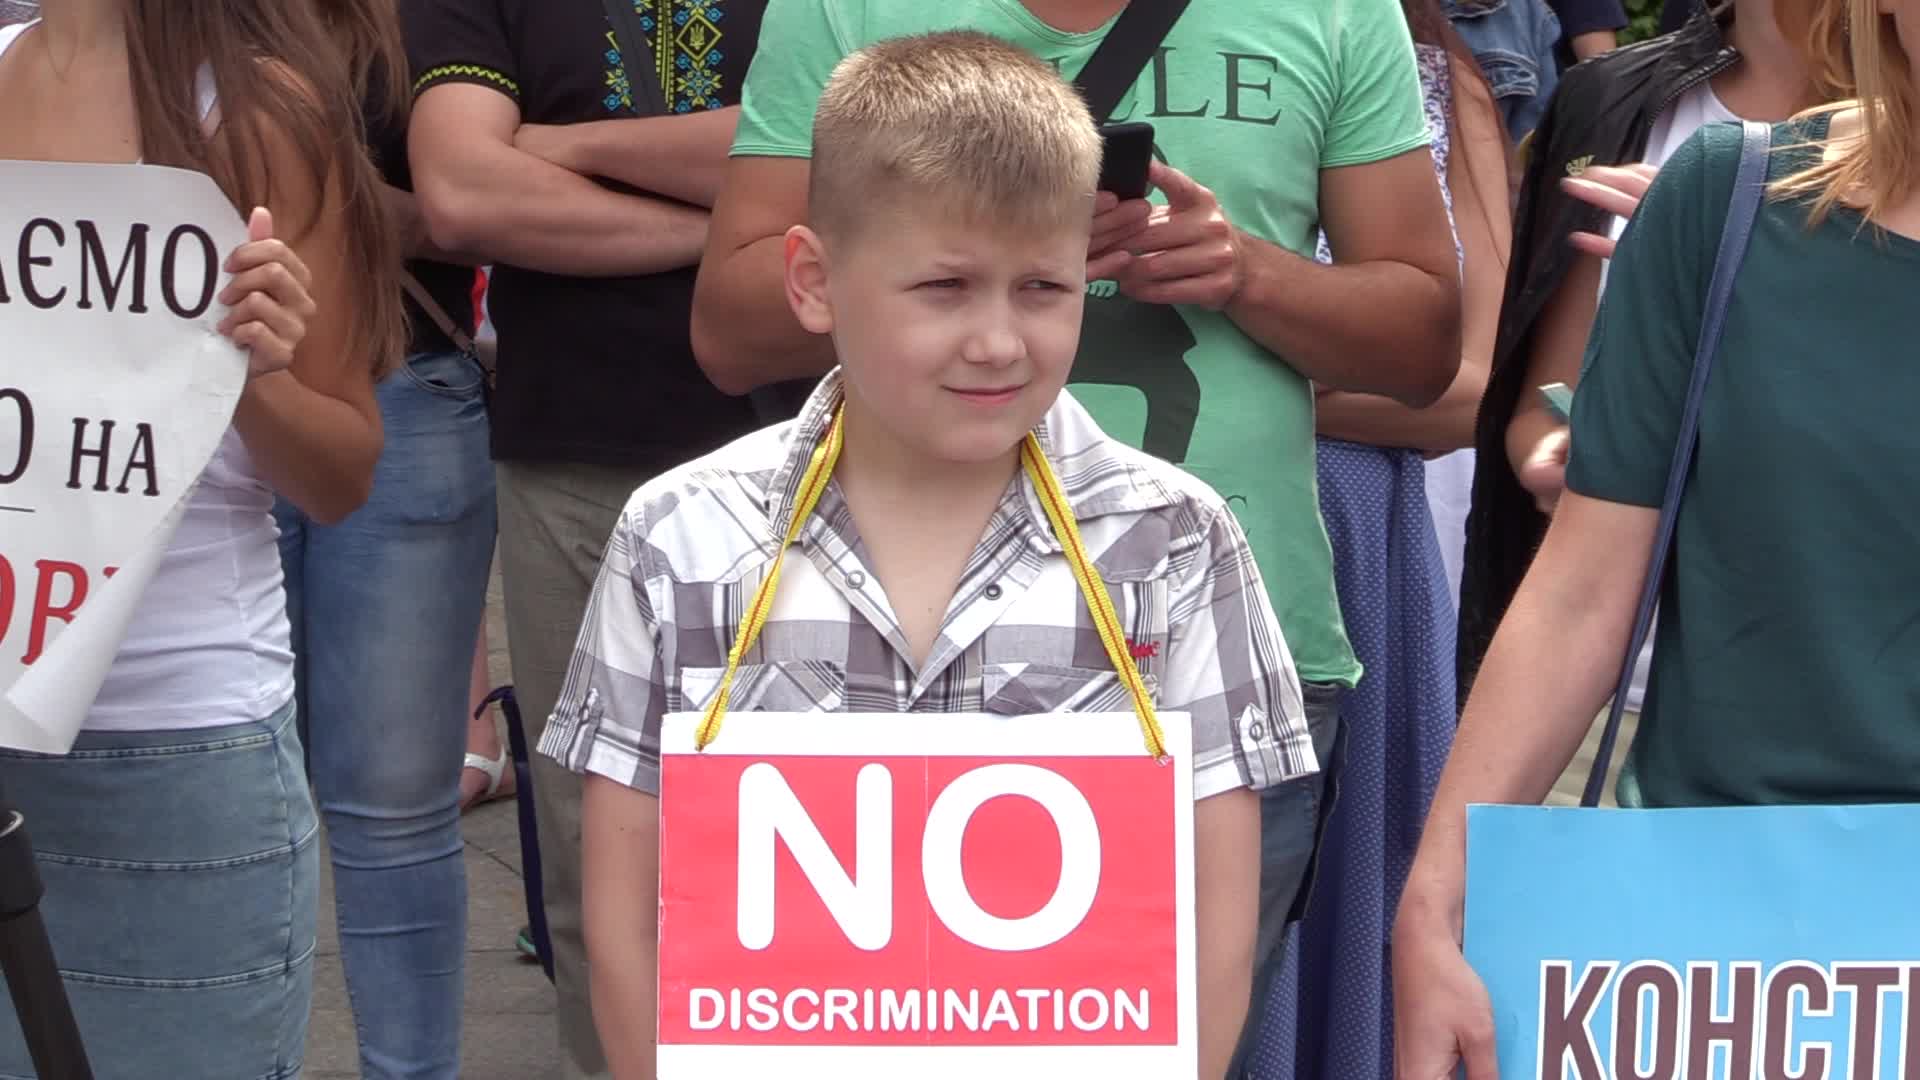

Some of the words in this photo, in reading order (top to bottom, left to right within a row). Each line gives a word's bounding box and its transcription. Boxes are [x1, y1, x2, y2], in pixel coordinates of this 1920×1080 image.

[1104, 46, 1282, 126] LE
[0, 217, 219, 319] ЄМО
[66, 417, 160, 496] НА
[737, 762, 1101, 951] NO
[688, 987, 1151, 1032] DISCRIMINATION
[1537, 960, 1920, 1080] КОНСТ
